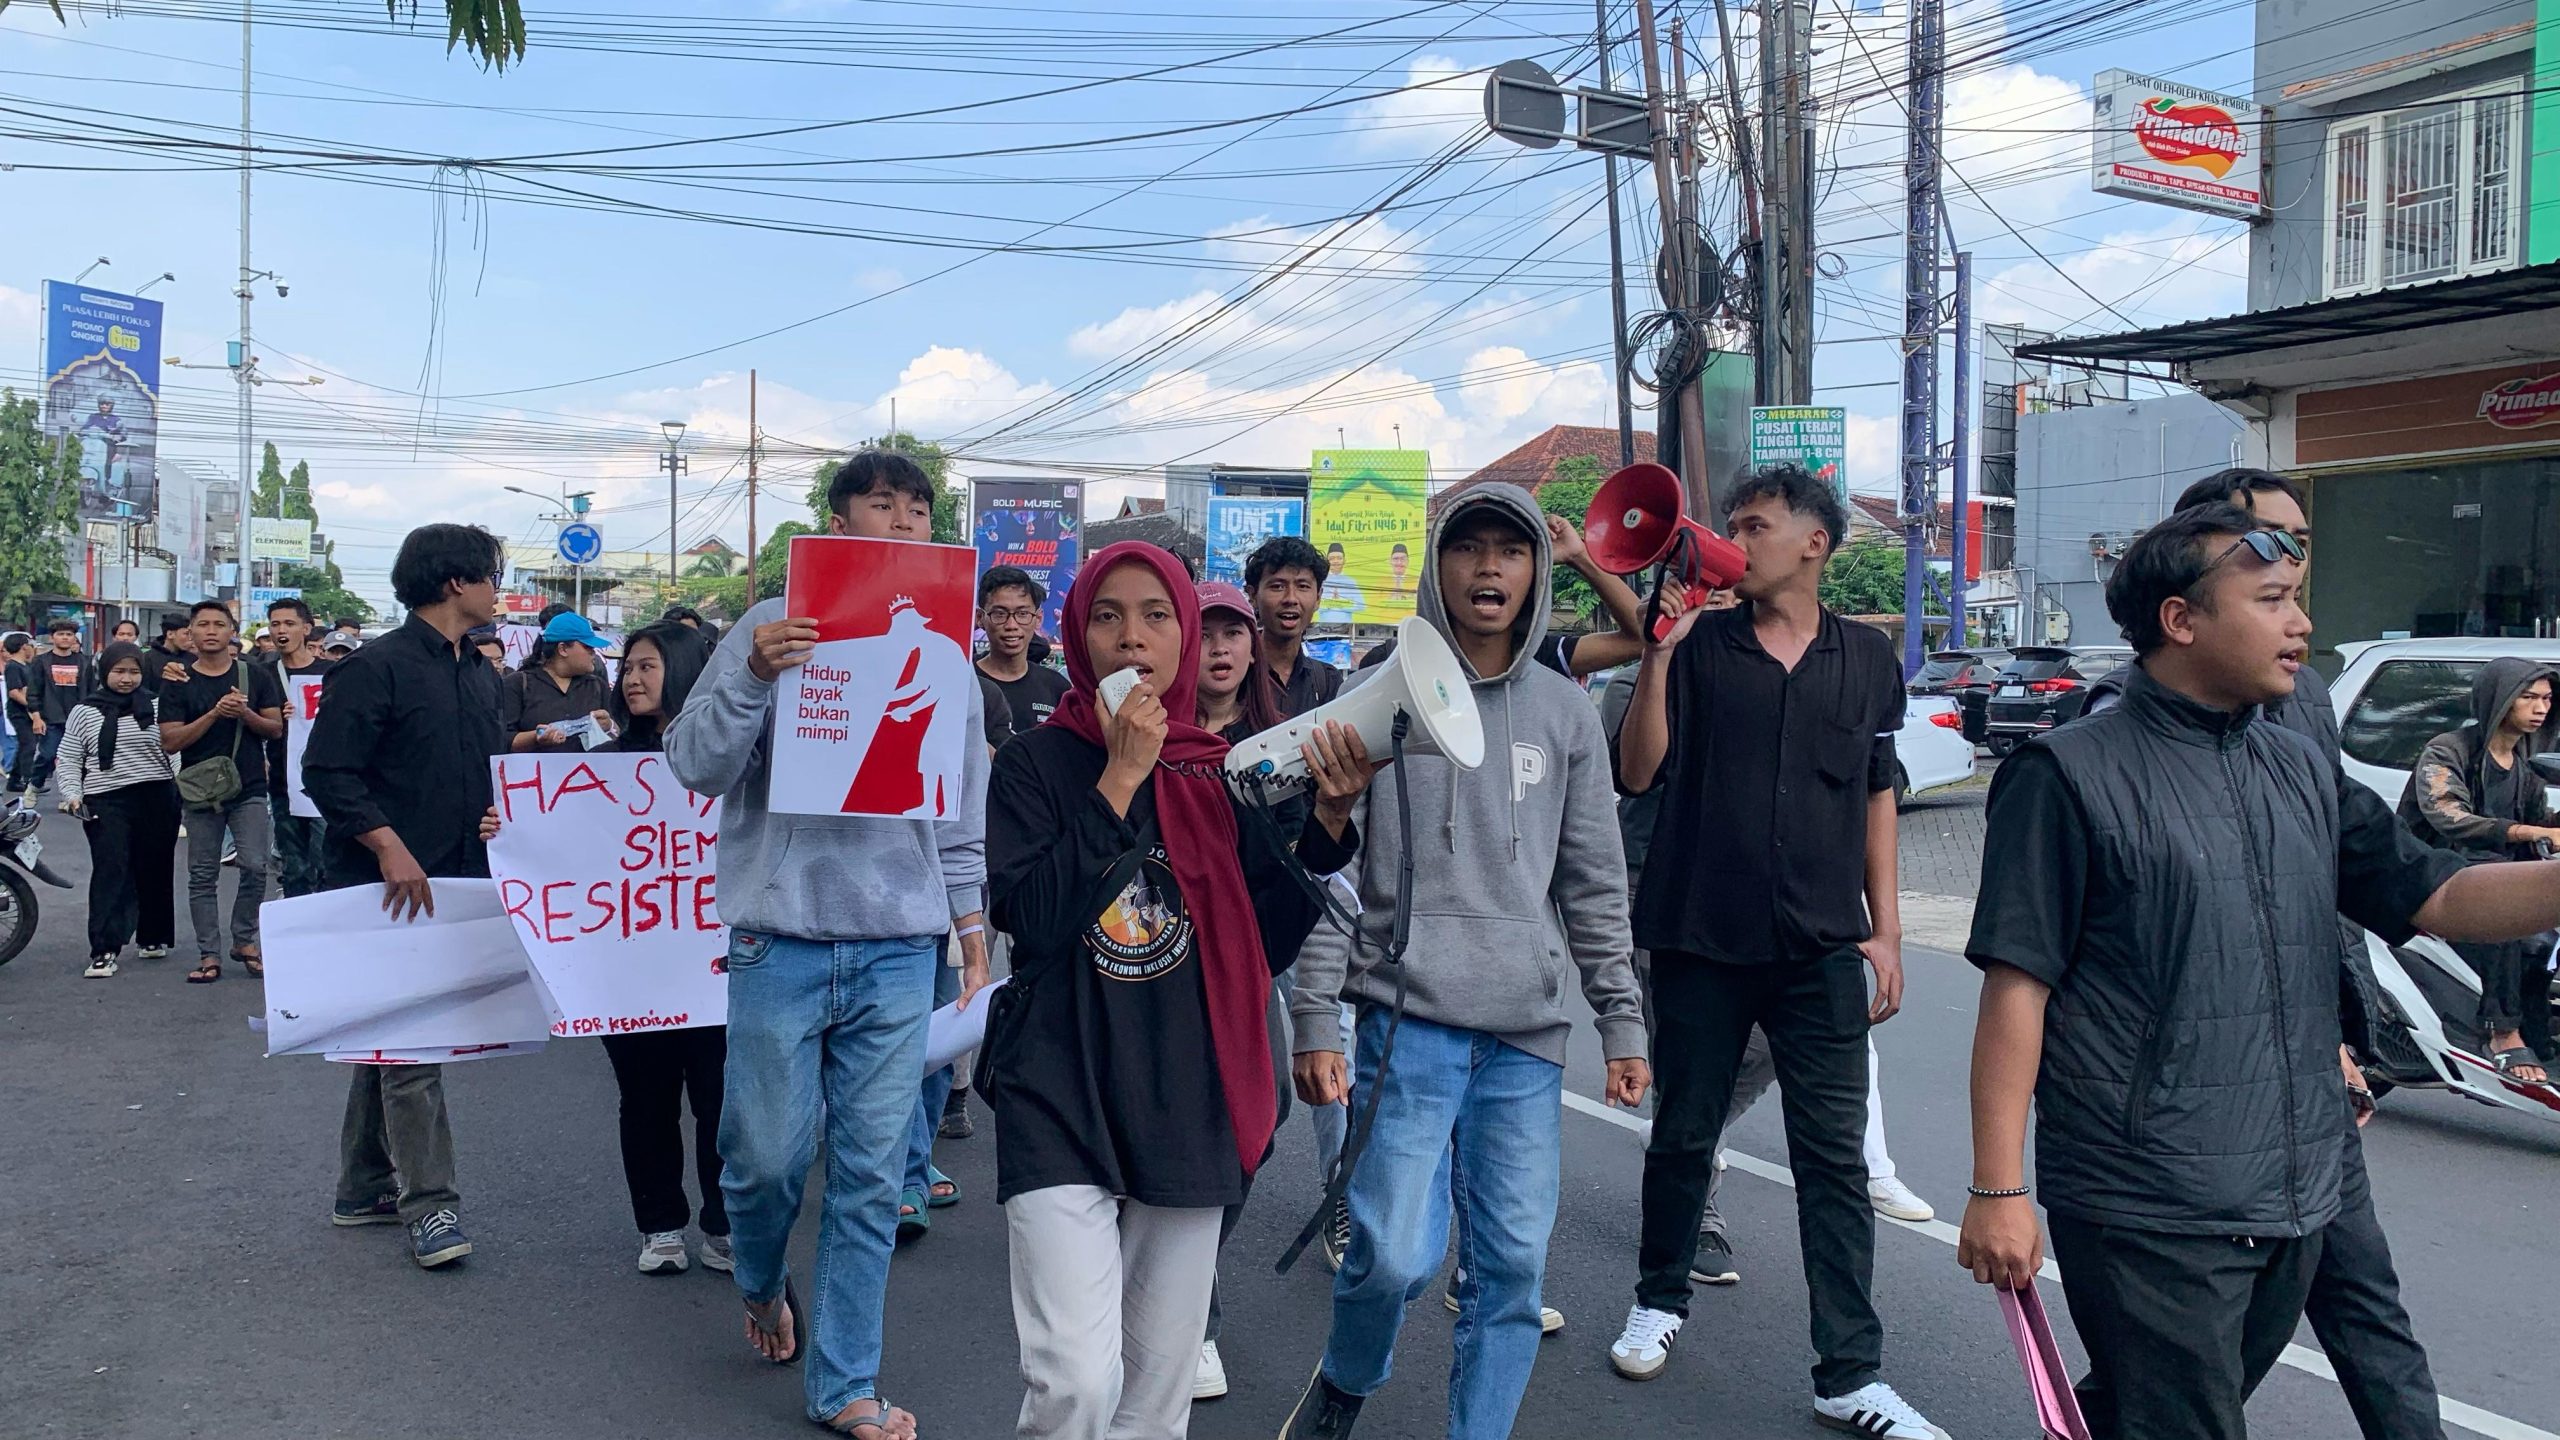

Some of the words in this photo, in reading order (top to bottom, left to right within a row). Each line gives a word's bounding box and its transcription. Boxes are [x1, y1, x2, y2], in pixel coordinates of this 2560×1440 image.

[2126, 74, 2150, 88] PUSAT
[2153, 80, 2197, 100] OLEH-OLEH
[2199, 91, 2220, 106] KHAS
[2222, 97, 2252, 113] JEMBER
[2129, 103, 2248, 157] Primadona
[62, 303, 92, 317] PUASA
[93, 309, 120, 322] LEBIH
[121, 315, 151, 328] FOKUS
[71, 320, 105, 333] PROMO
[70, 330, 105, 344] ONGKIR
[1768, 409, 1829, 420] MUBARAK
[1755, 421, 1796, 434] PUSAT
[1798, 421, 1842, 433] TERAPI
[1755, 434, 1798, 447] TINGGI
[1801, 434, 1842, 446] BADAN
[1755, 448, 1802, 460] TAMBAH
[1805, 447, 1822, 458] 1-8
[1825, 447, 1843, 458] CM
[993, 499, 1016, 507] BOLD
[1024, 499, 1063, 509] MUSIC
[1220, 507, 1290, 533] IDNET
[1326, 519, 1345, 534] Idul
[1347, 519, 1372, 533] Fitri
[1374, 519, 1397, 531] 1446
[1400, 519, 1408, 531] H
[255, 537, 303, 546] ELEKTRONIK
[1007, 542, 1018, 551] WIN
[1026, 540, 1058, 553] BOLD
[992, 551, 1059, 568] XPERIENCE
[802, 664, 852, 686] Hidup
[800, 683, 843, 704] layak
[798, 703, 850, 721] bukan
[796, 723, 848, 744] mimpi
[1510, 741, 1547, 802] P
[1109, 962, 1142, 976] EKONOMI
[1144, 953, 1173, 974] INKLUSIF
[572, 1017, 604, 1035] FOR
